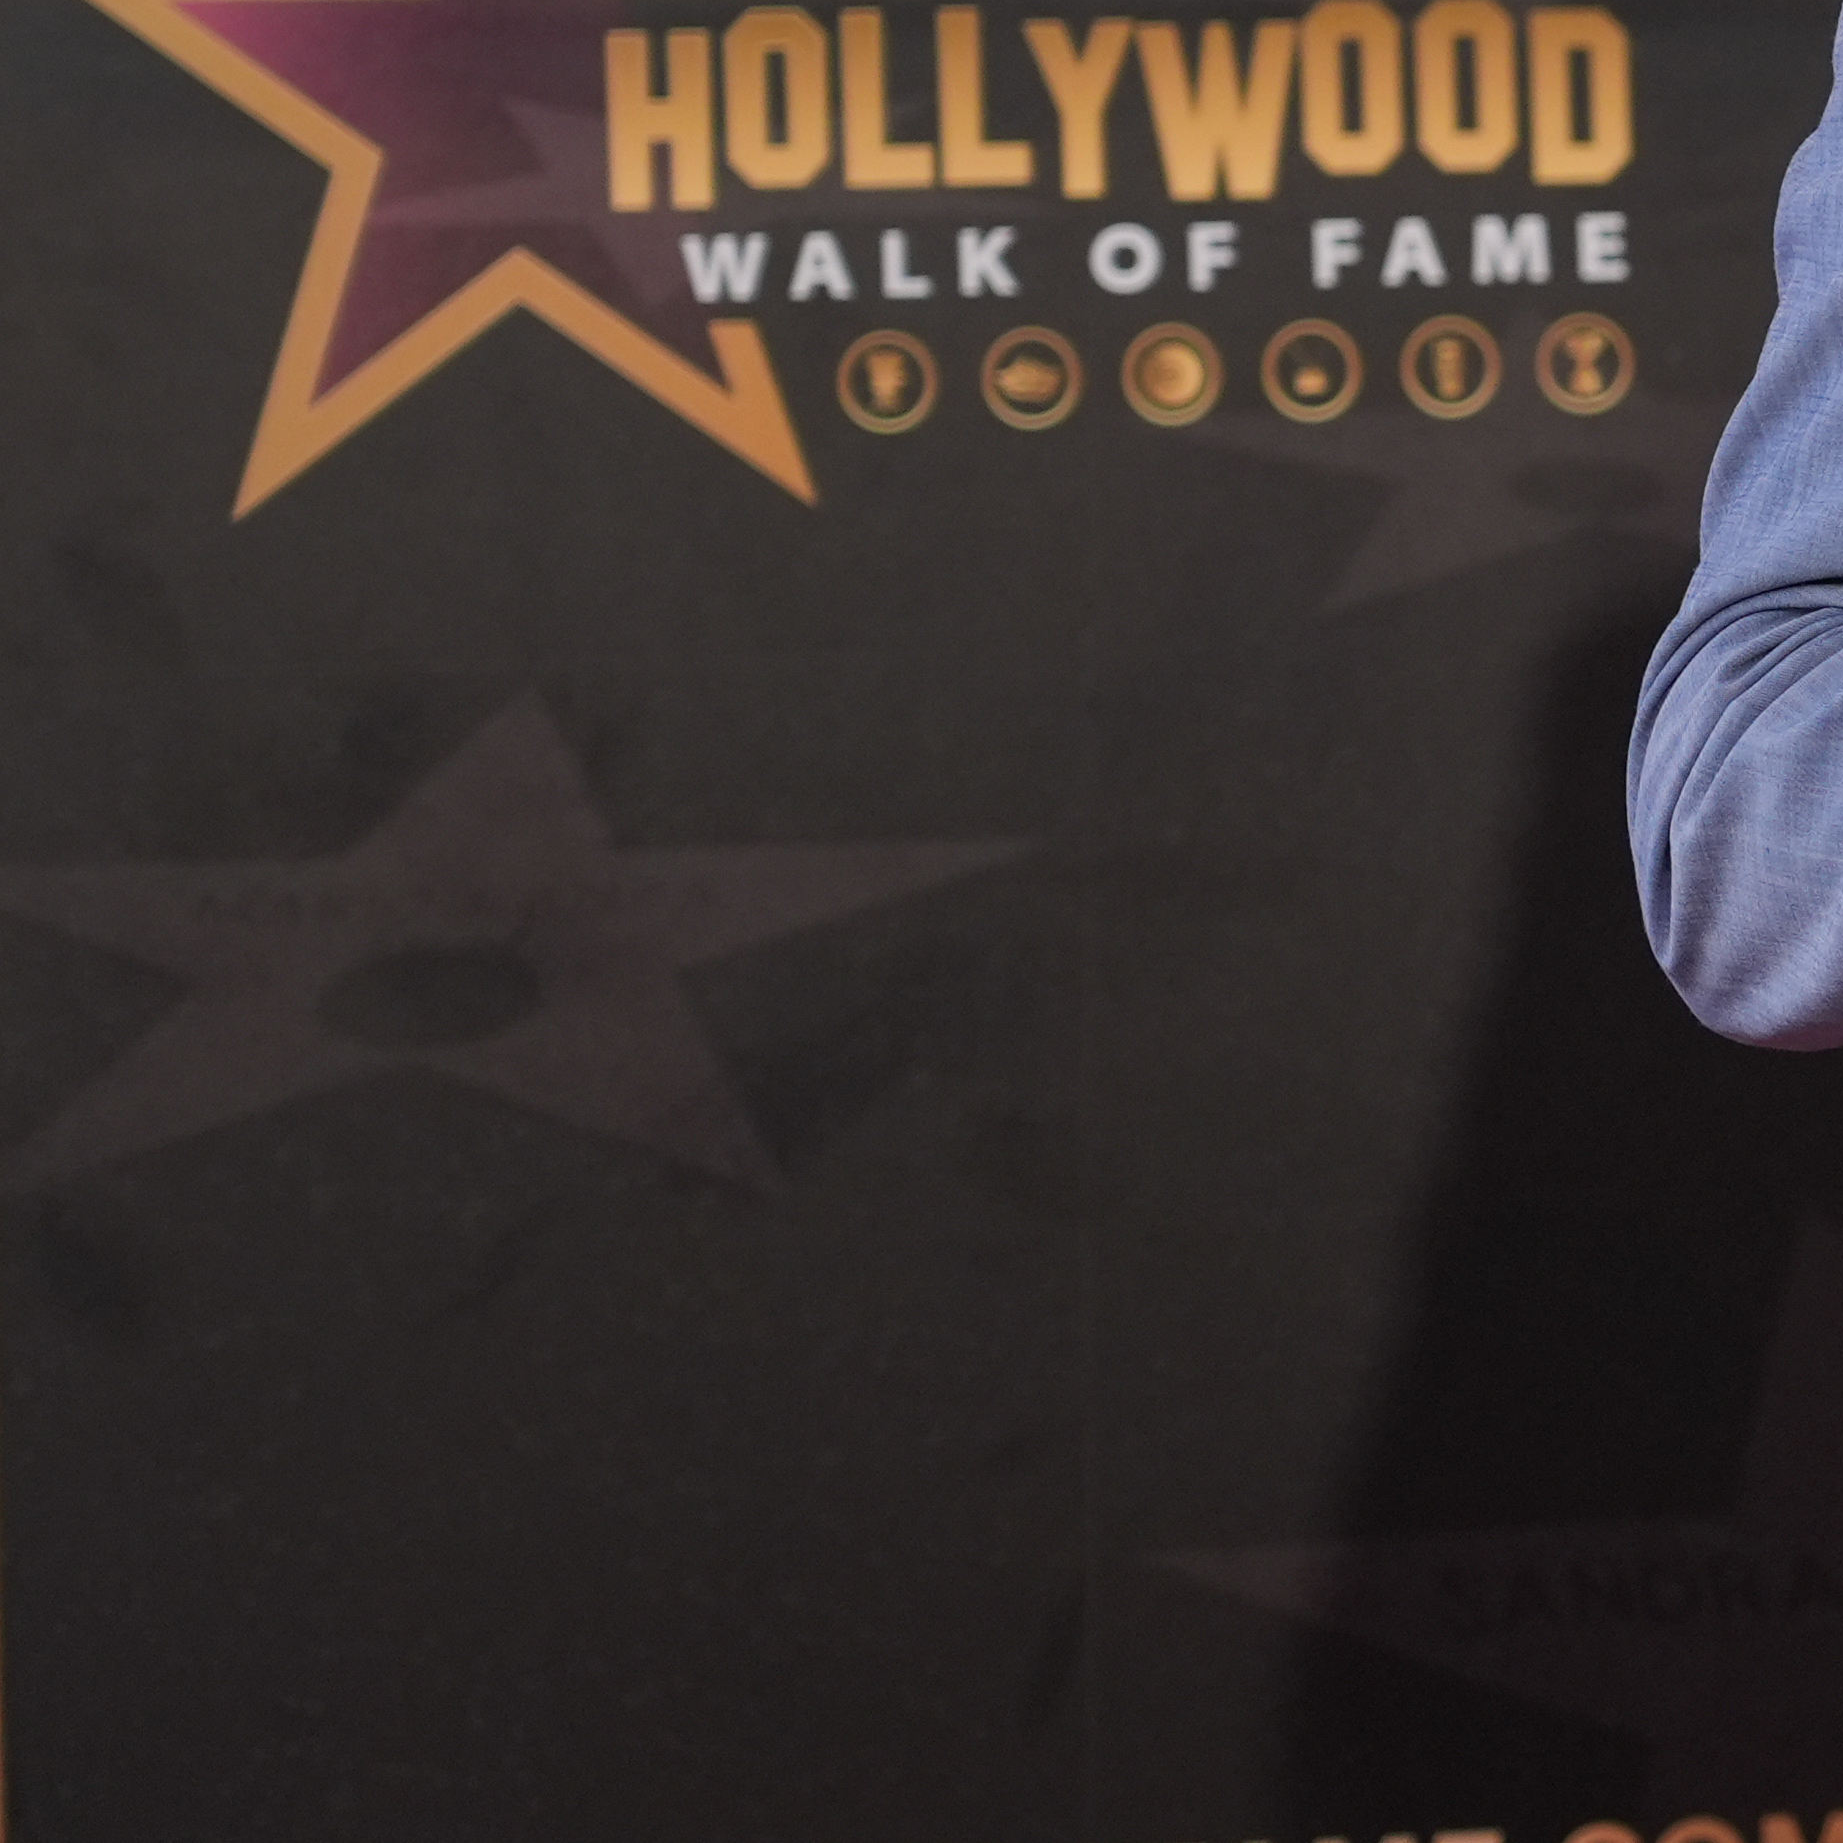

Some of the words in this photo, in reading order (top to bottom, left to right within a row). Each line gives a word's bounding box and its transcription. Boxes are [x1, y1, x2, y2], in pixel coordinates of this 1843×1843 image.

[681, 226, 1018, 303] WALK
[1089, 220, 1236, 294] OF
[1312, 210, 1629, 288] FAME
